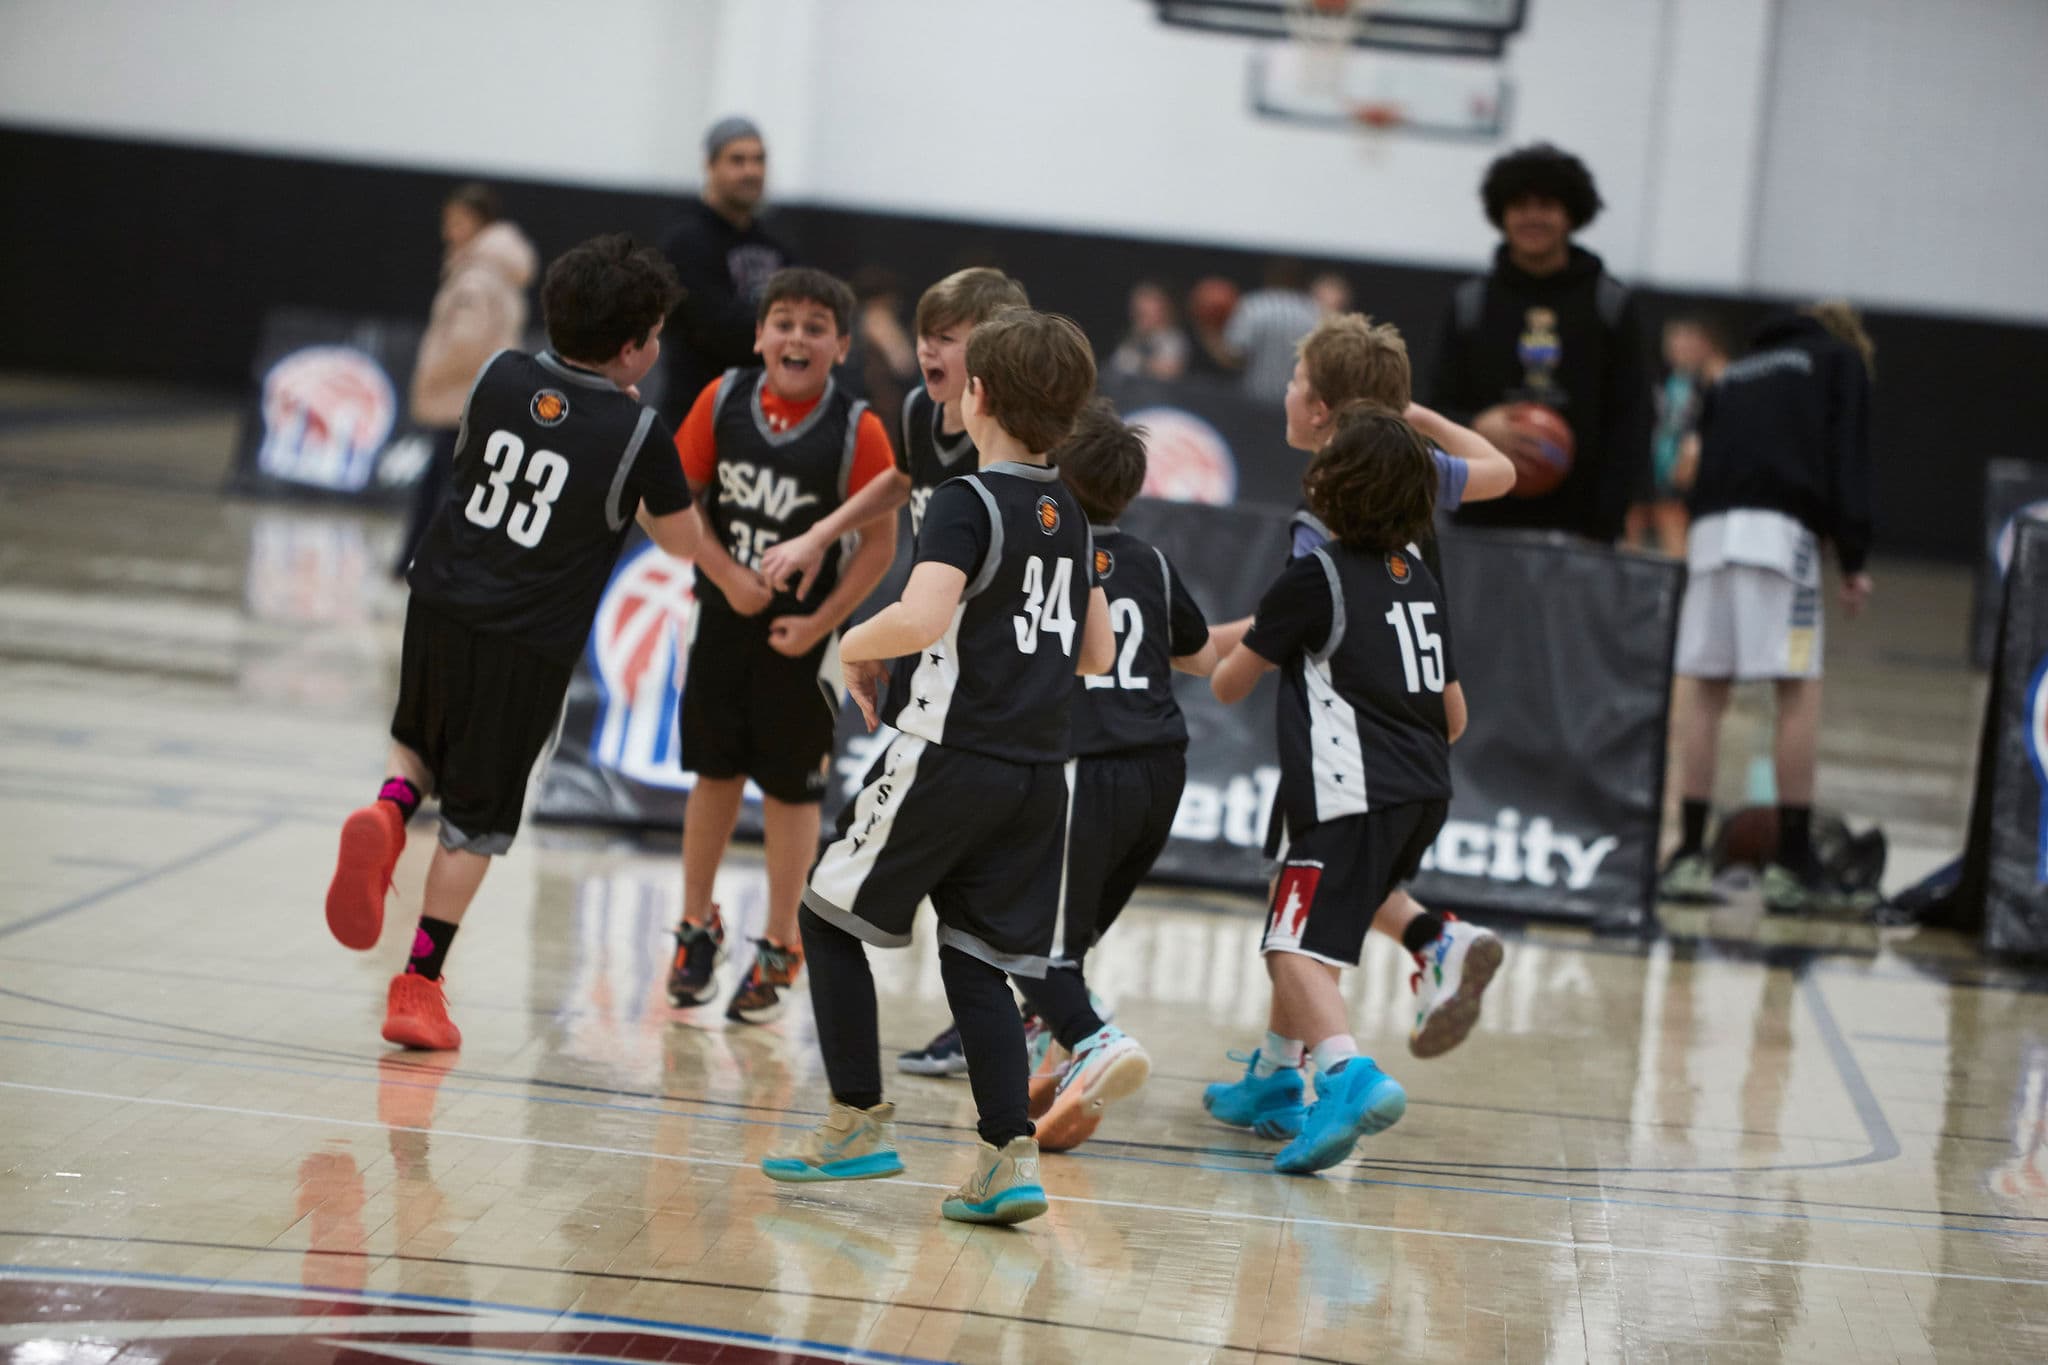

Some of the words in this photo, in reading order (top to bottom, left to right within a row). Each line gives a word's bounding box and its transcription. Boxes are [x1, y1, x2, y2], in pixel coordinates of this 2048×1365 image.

[464, 428, 570, 549] 33
[717, 461, 817, 521] SSNY
[1013, 555, 1077, 658] 34
[1384, 600, 1446, 693] 15
